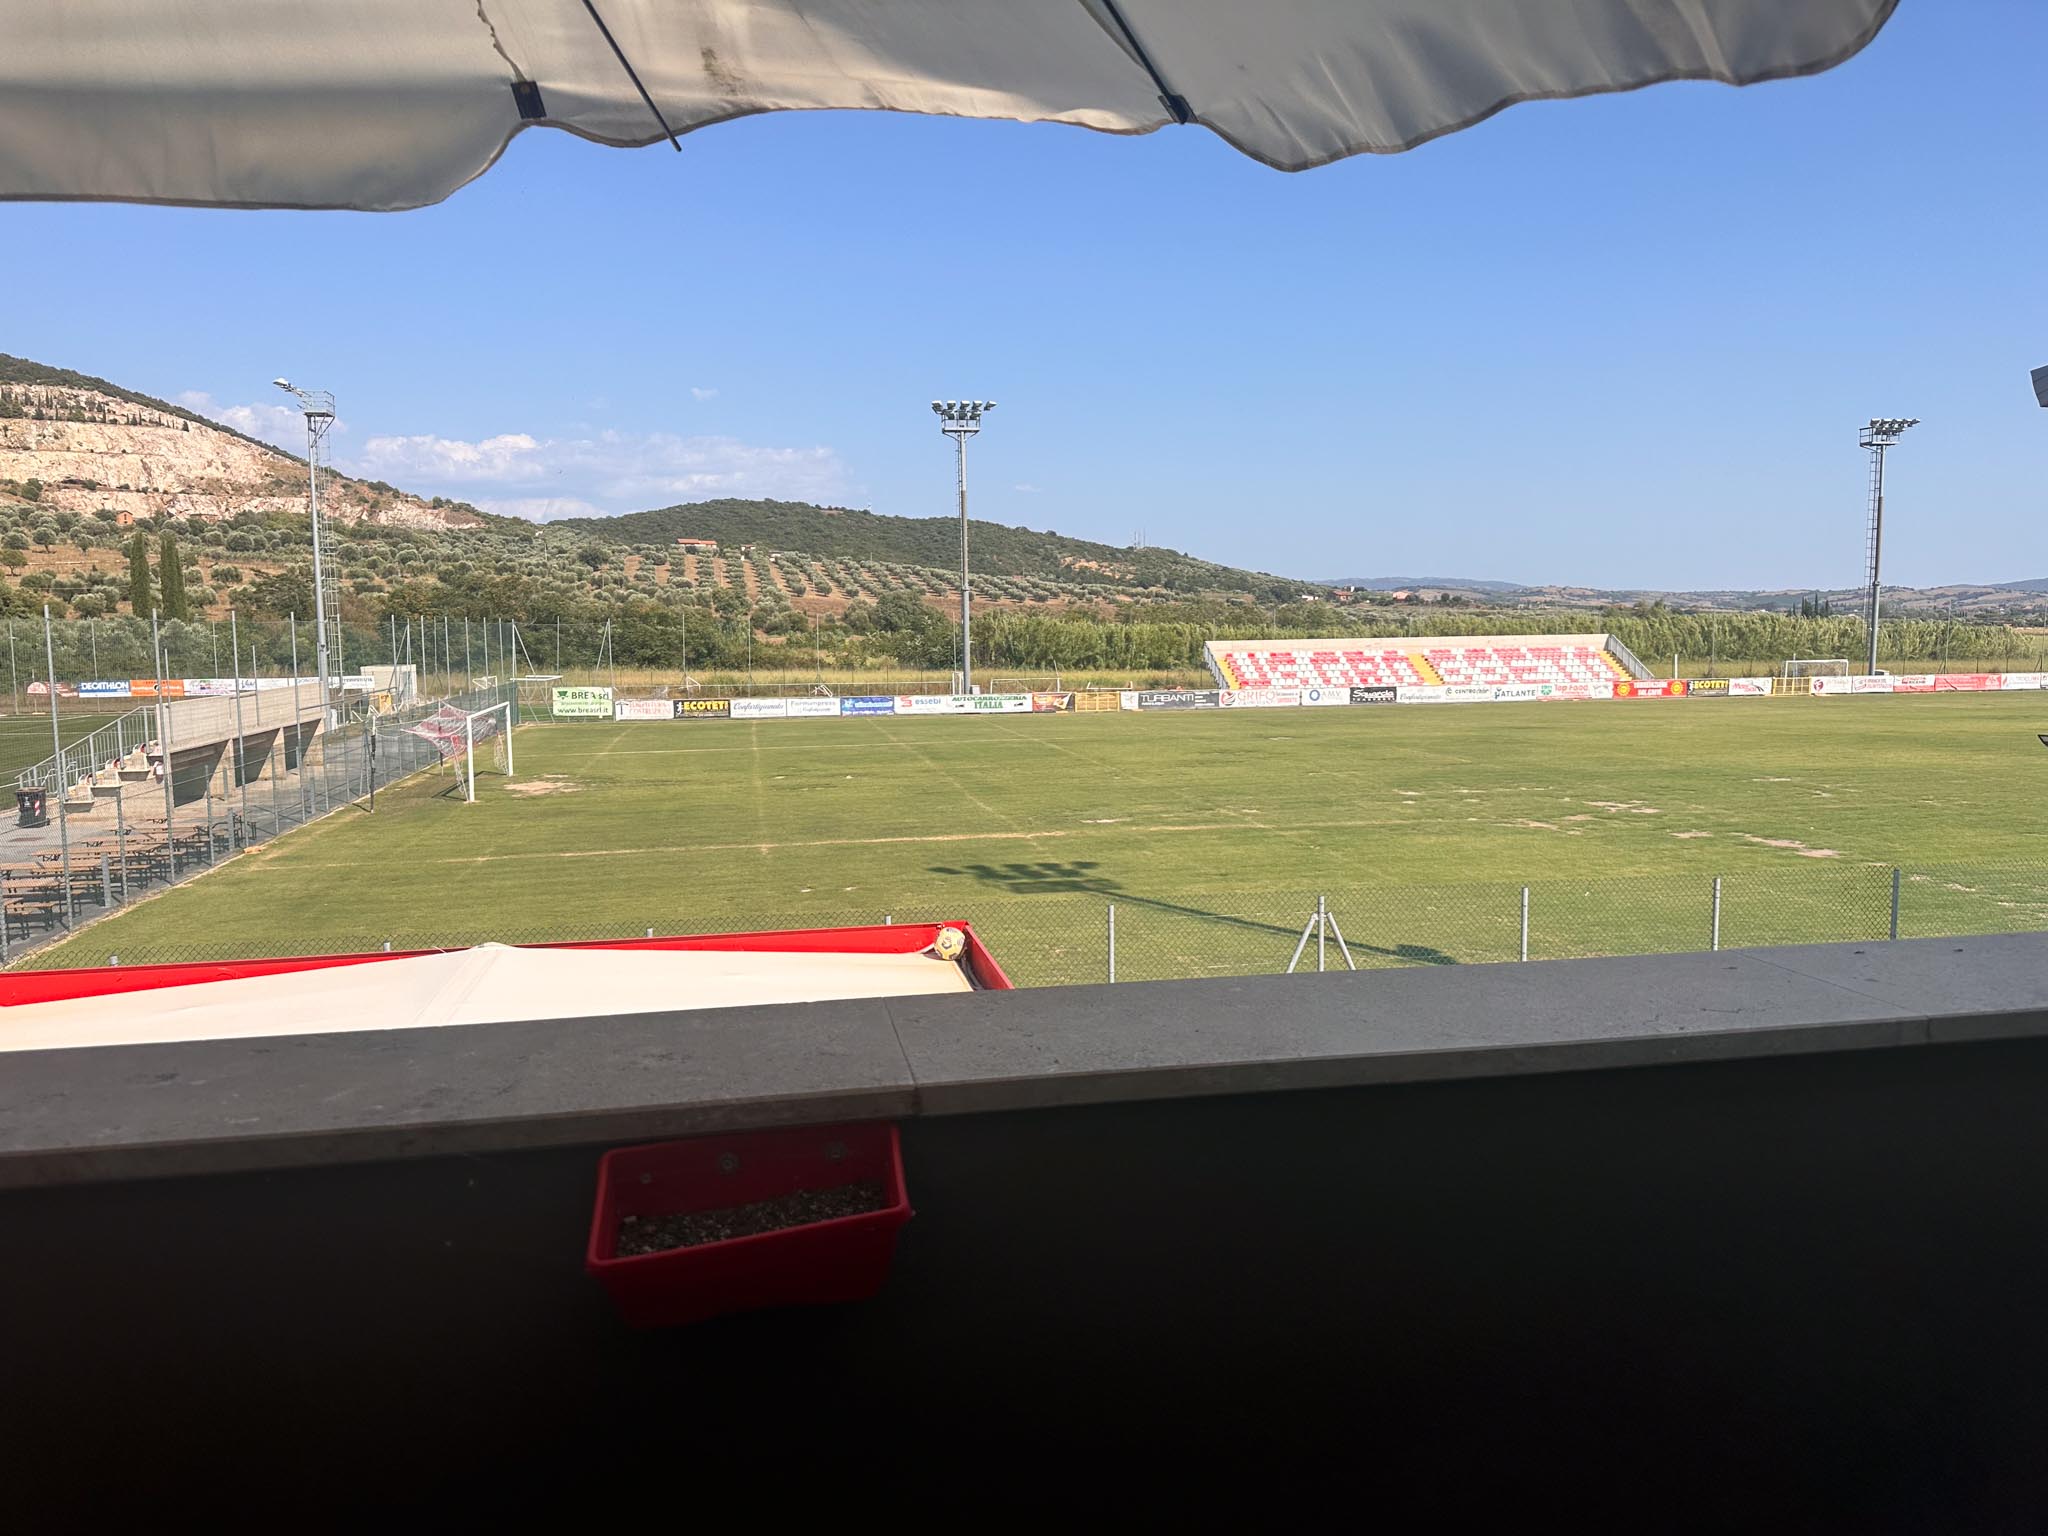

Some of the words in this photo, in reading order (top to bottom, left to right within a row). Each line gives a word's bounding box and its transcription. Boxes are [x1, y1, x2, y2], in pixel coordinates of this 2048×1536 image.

[81, 682, 129, 690] DECATHLON
[1140, 693, 1194, 702] TURBANTI
[1501, 689, 1536, 698] ATLANTE
[974, 701, 1004, 709] ITALIA
